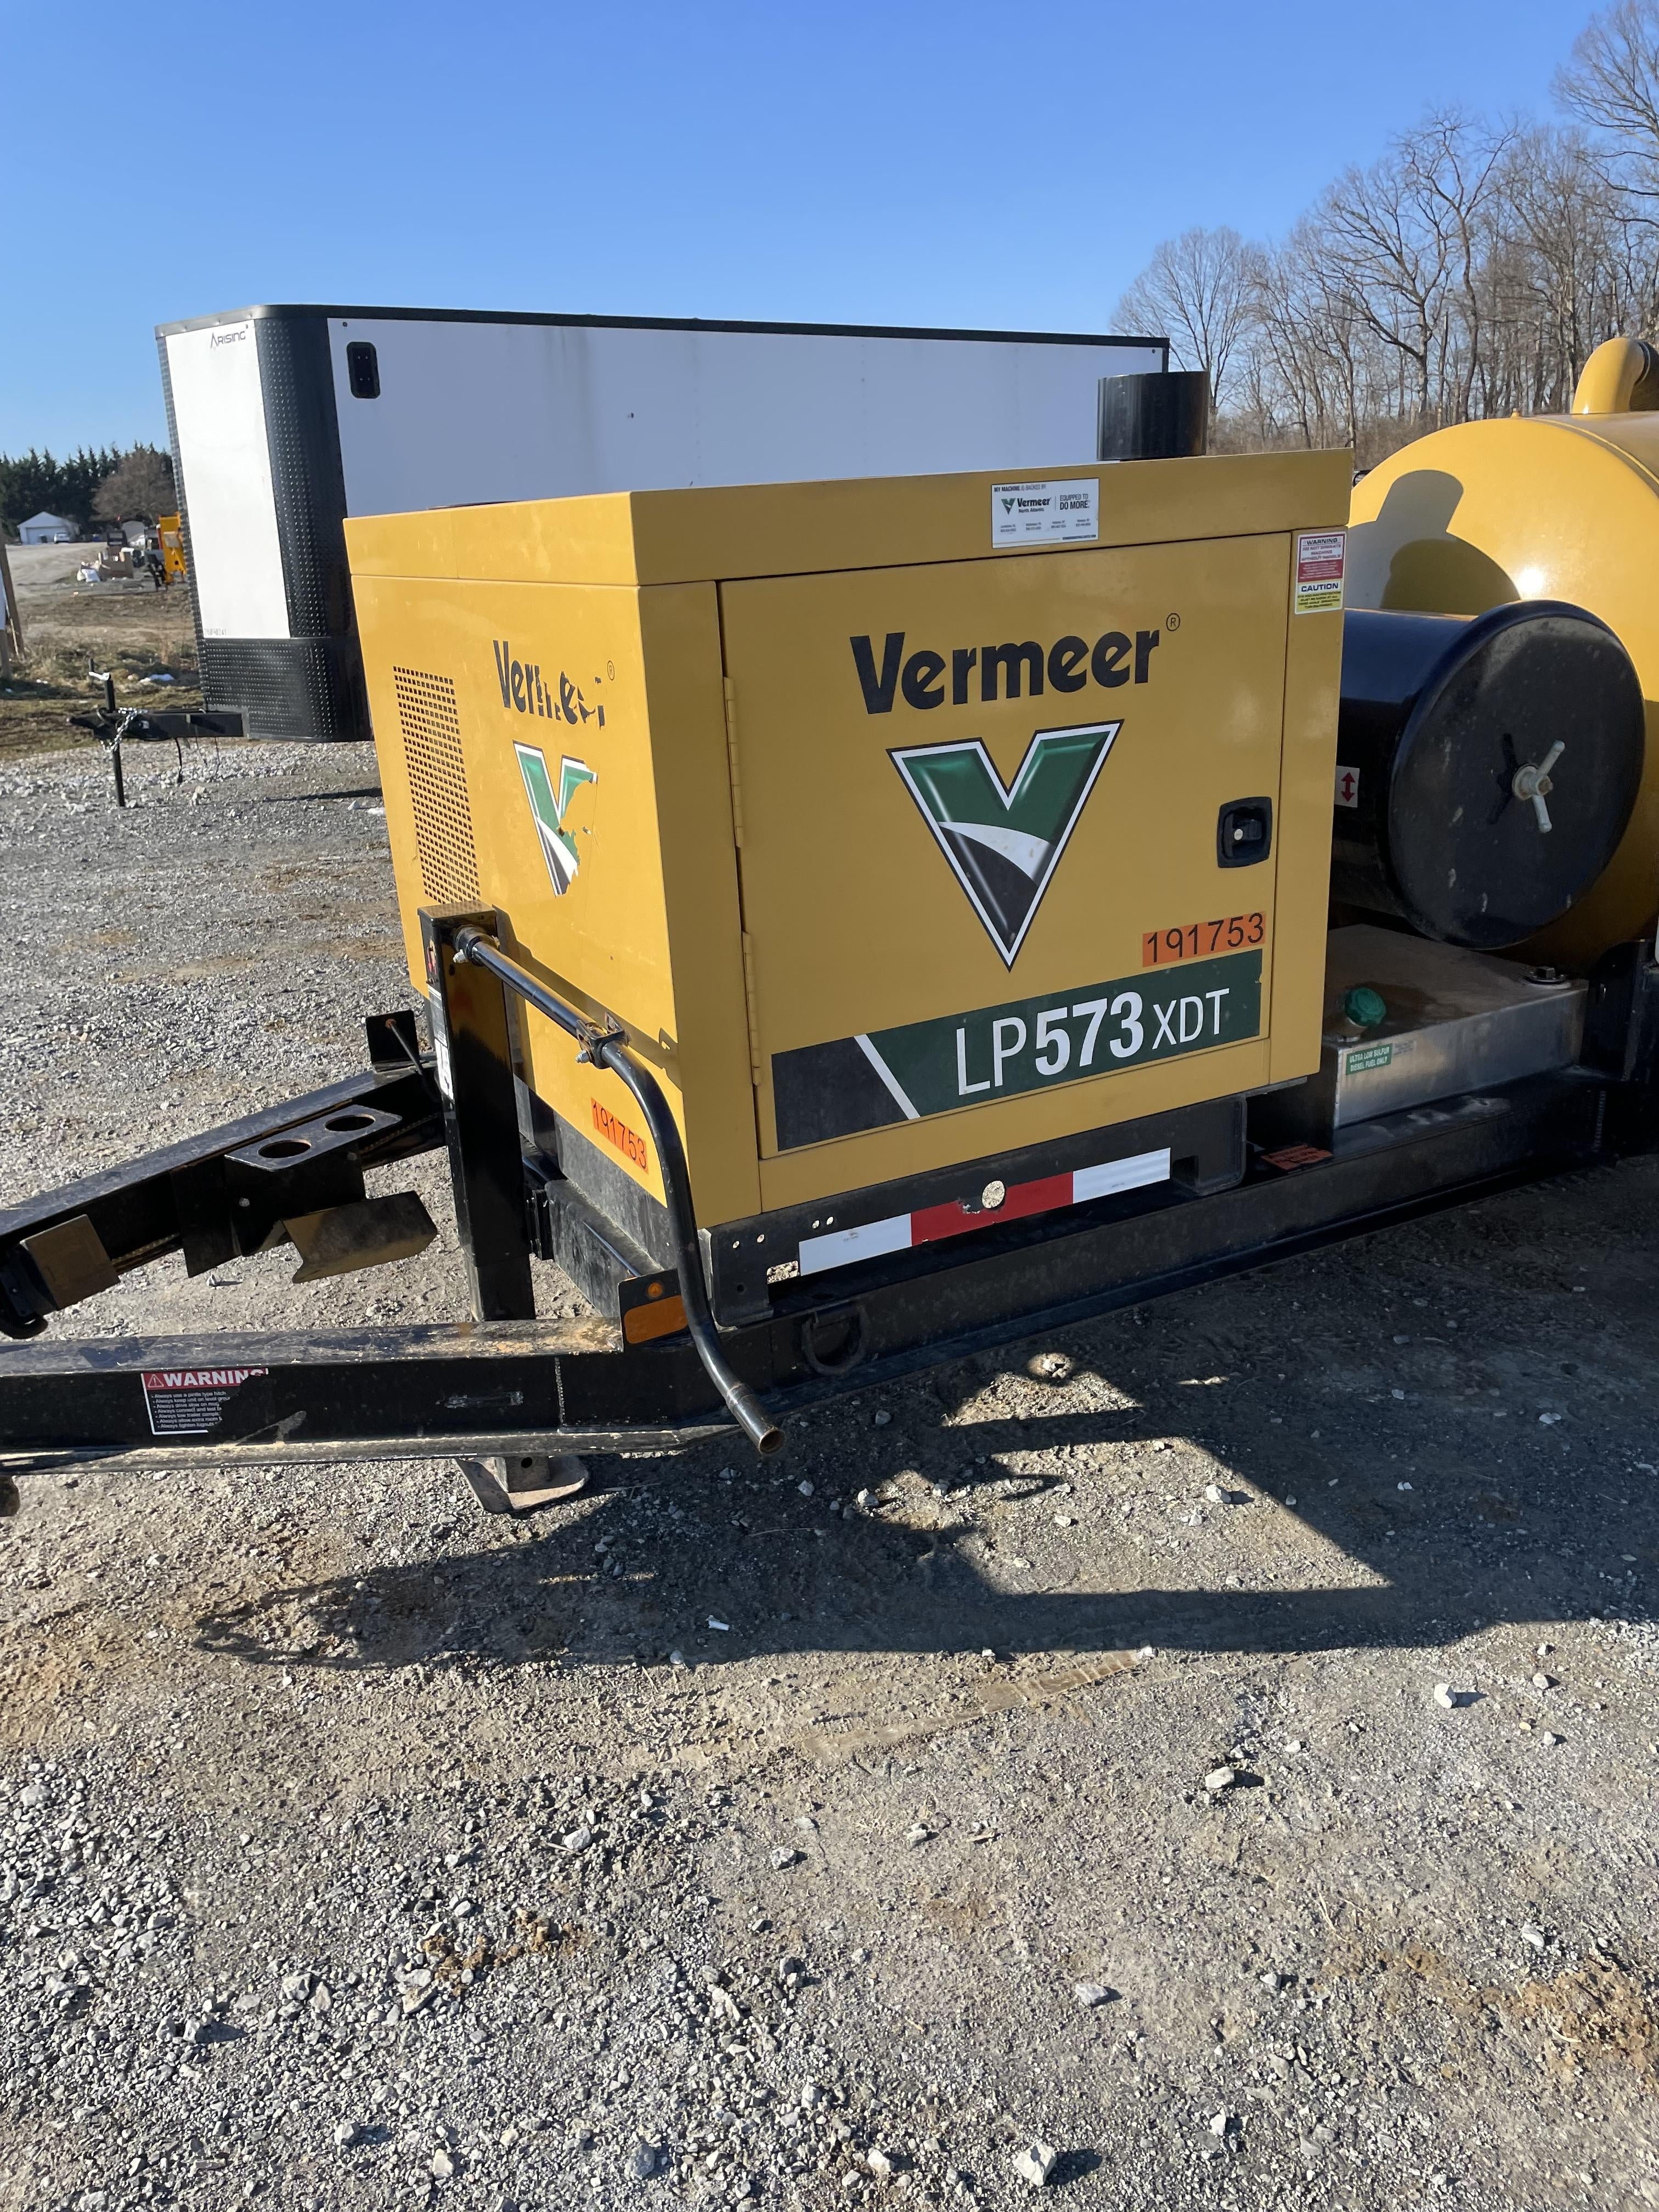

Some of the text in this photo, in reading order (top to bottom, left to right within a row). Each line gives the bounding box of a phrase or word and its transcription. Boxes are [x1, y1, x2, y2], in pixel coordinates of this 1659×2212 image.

[211, 331, 246, 348] ARISING
[1017, 498, 1051, 507] Vermeer
[1060, 501, 1069, 510] DO
[1301, 583, 1339, 592] CAUTION
[849, 629, 1160, 714] Vermeer
[1146, 912, 1264, 963] 191753
[1350, 1053, 1363, 1063] ULTRA
[1364, 1051, 1374, 1060] LOW
[1374, 1046, 1390, 1057] SULFUR
[1350, 1056, 1388, 1072] DIESEL FUEL ONLY
[593, 1101, 647, 1169] 191753
